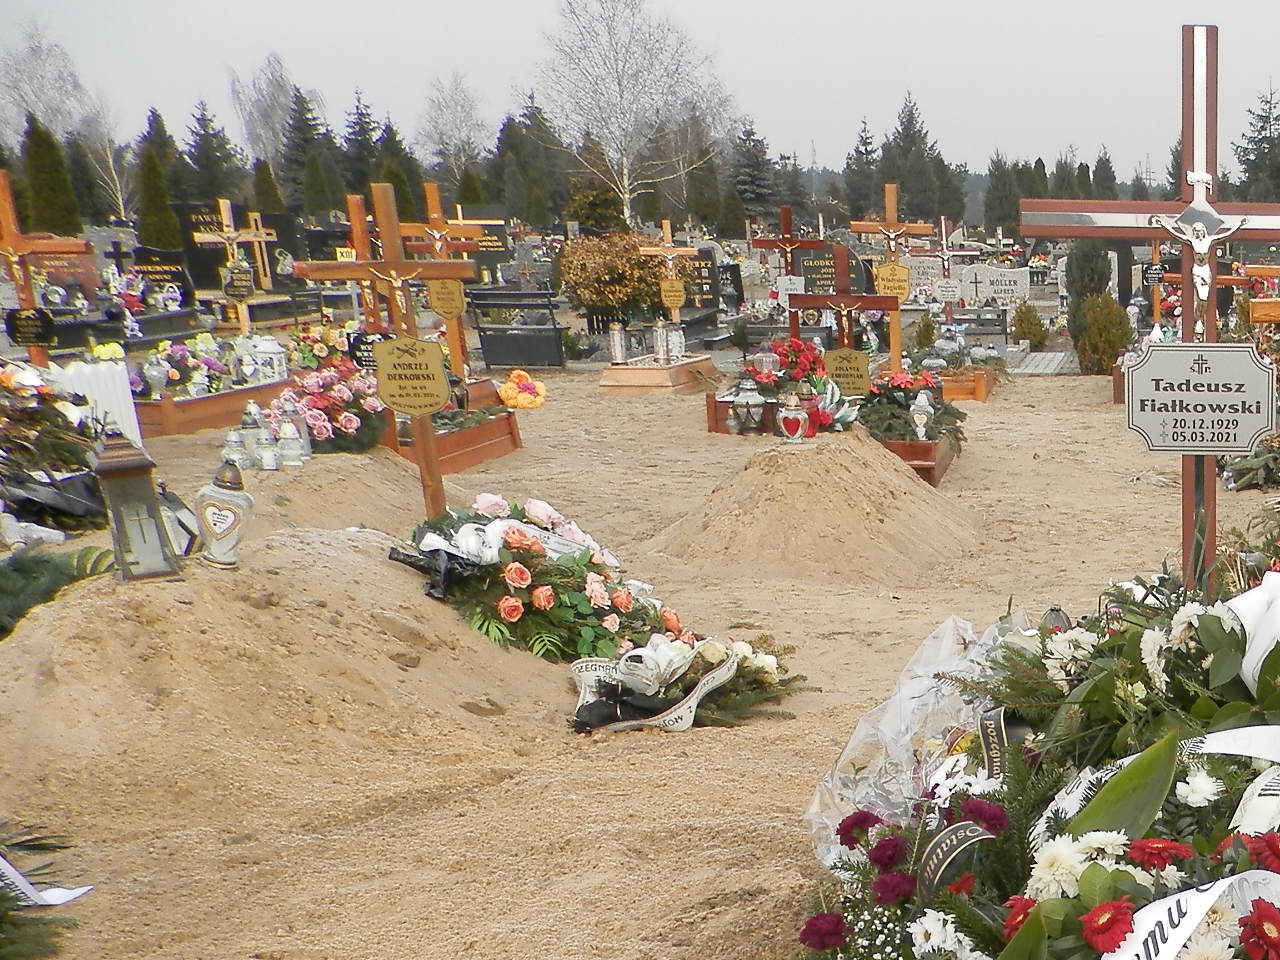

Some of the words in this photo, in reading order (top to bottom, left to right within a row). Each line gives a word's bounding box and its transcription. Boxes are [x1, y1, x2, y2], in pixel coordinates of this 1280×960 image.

[392, 362, 429, 370] ANDRZEJ
[1151, 378, 1247, 393] Tadeusz
[1139, 399, 1262, 415] Fiałkowski
[1172, 418, 1239, 430] 20.12.1929
[1171, 431, 1237, 443] 05.03.2021
